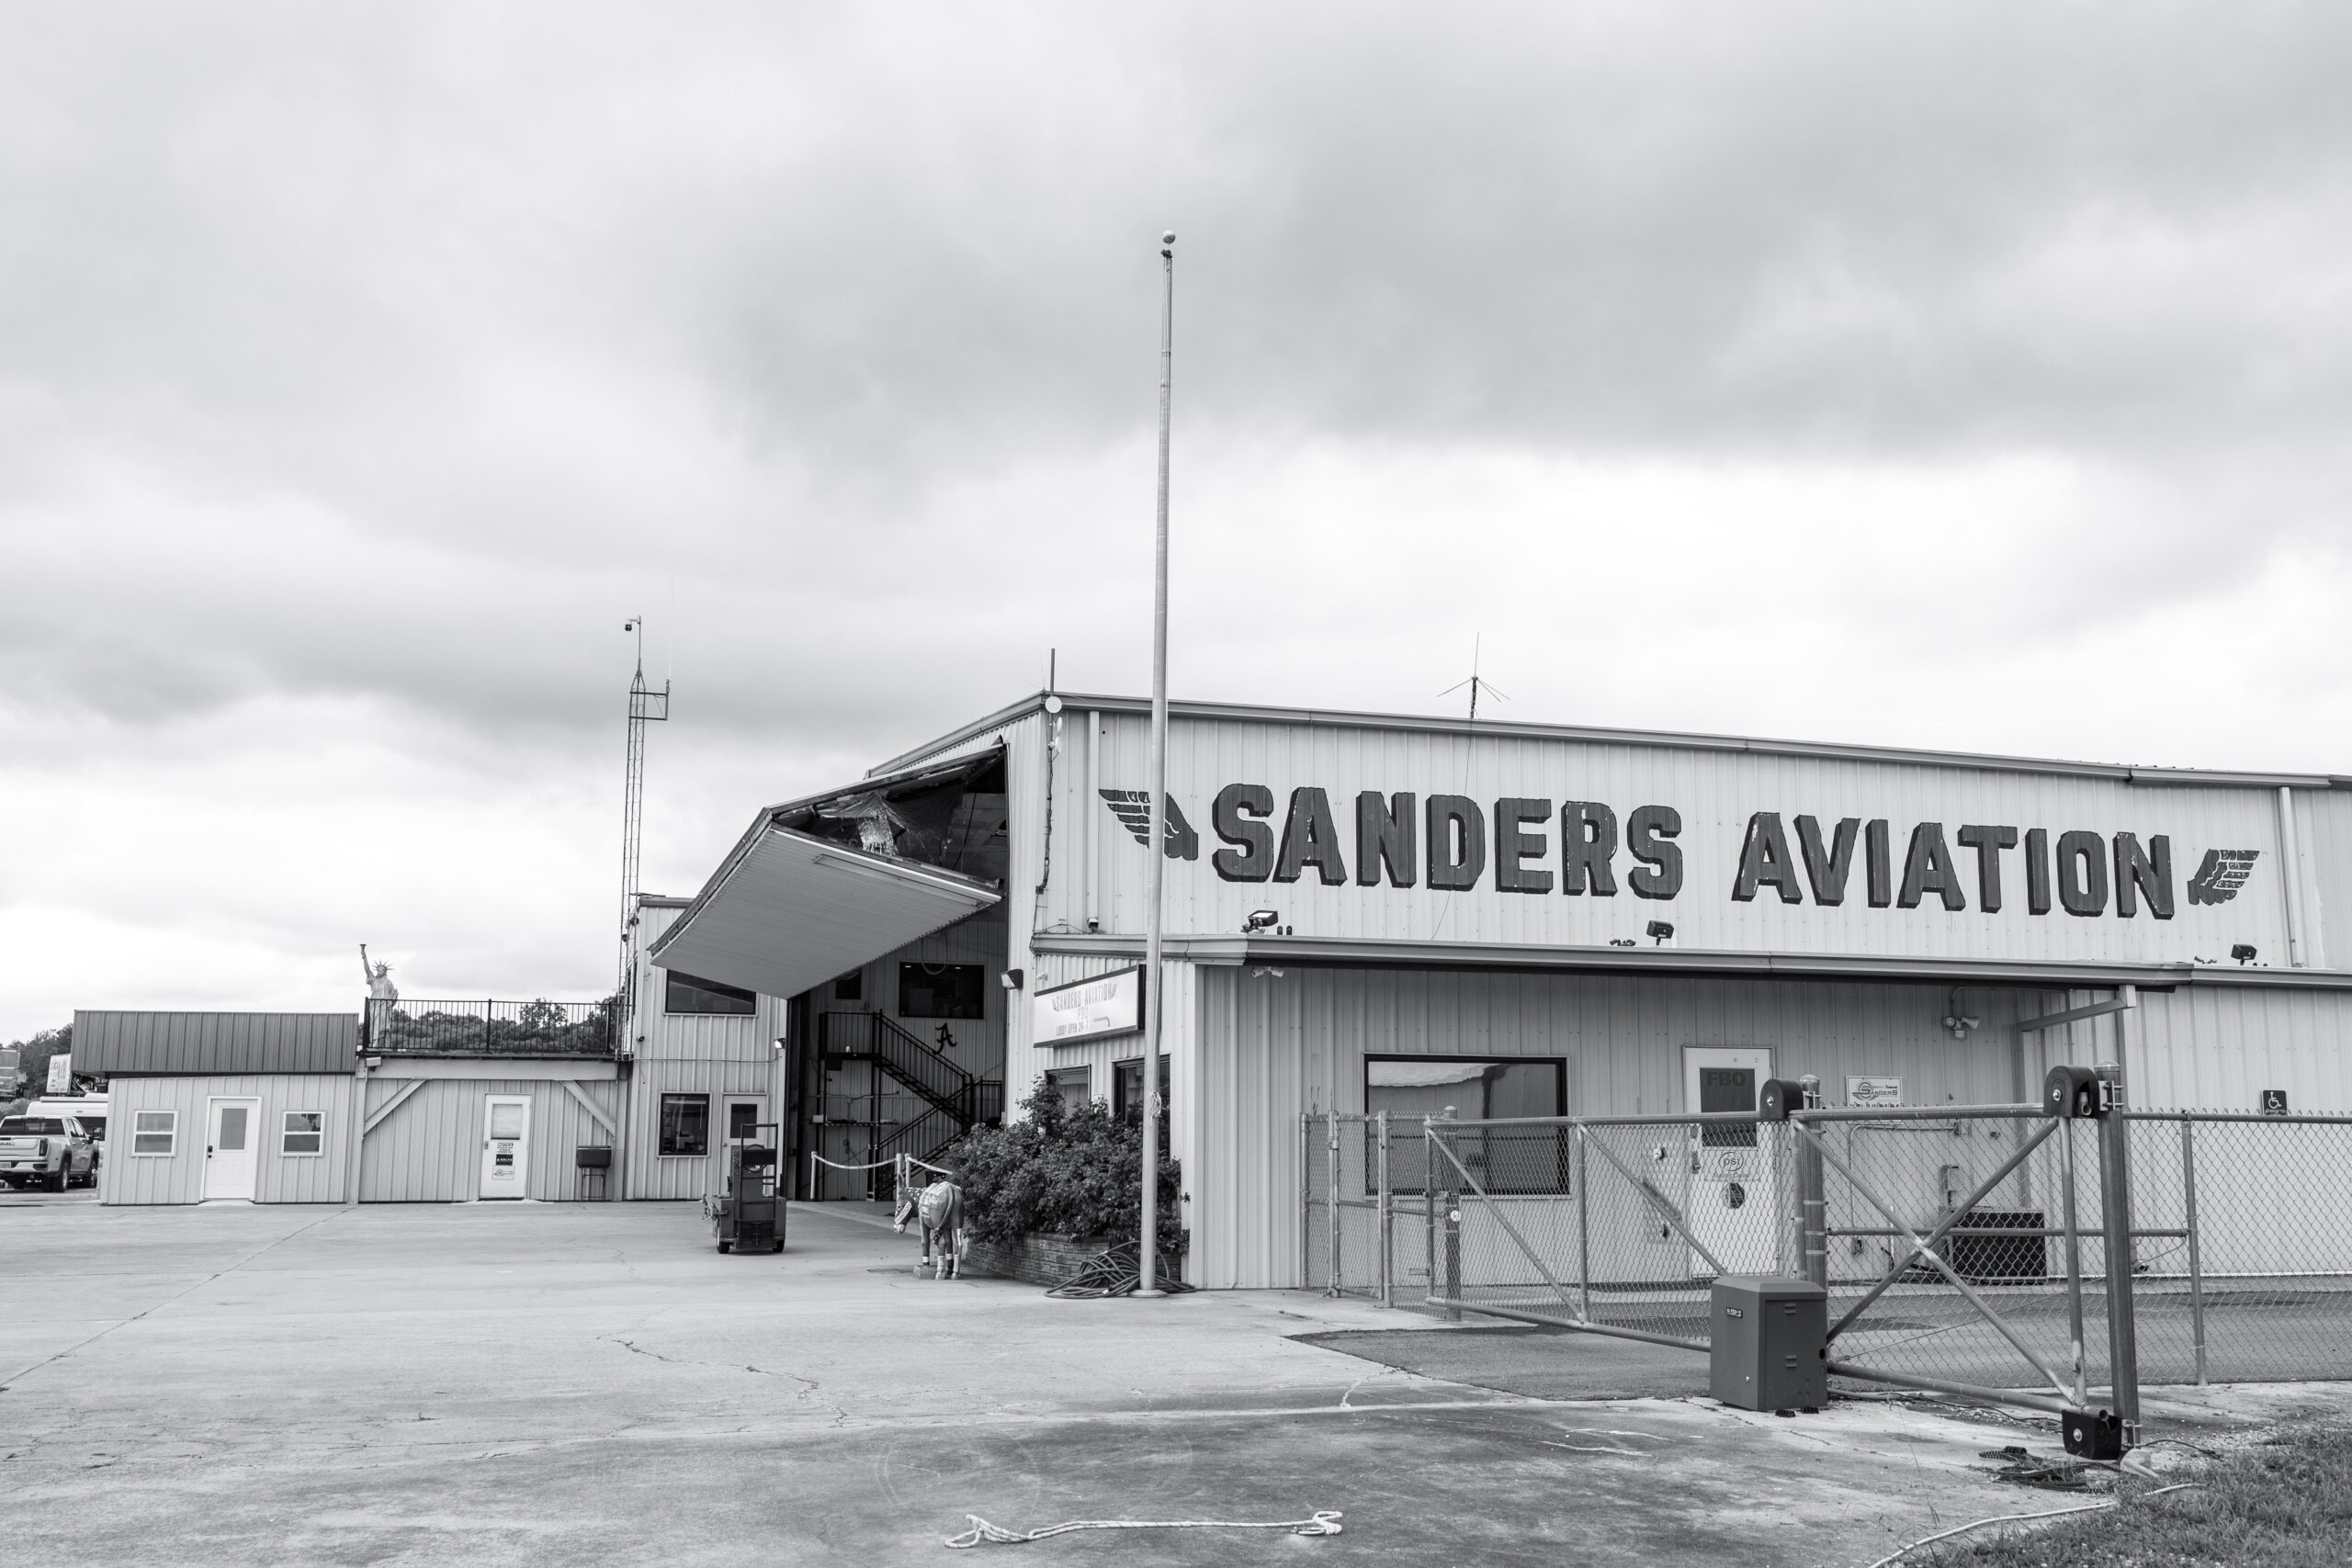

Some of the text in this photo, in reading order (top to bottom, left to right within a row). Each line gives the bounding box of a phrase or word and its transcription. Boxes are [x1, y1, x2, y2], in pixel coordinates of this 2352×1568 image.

[1211, 783, 2176, 920] SANDERS AVIATION
[1057, 984, 1113, 1012] SANDERS AVIATION
[1078, 1007, 1089, 1021] FBO
[1068, 1022, 1077, 1034] OPEN
[1706, 1070, 1745, 1087] FBO
[1723, 1156, 1740, 1168] psi
